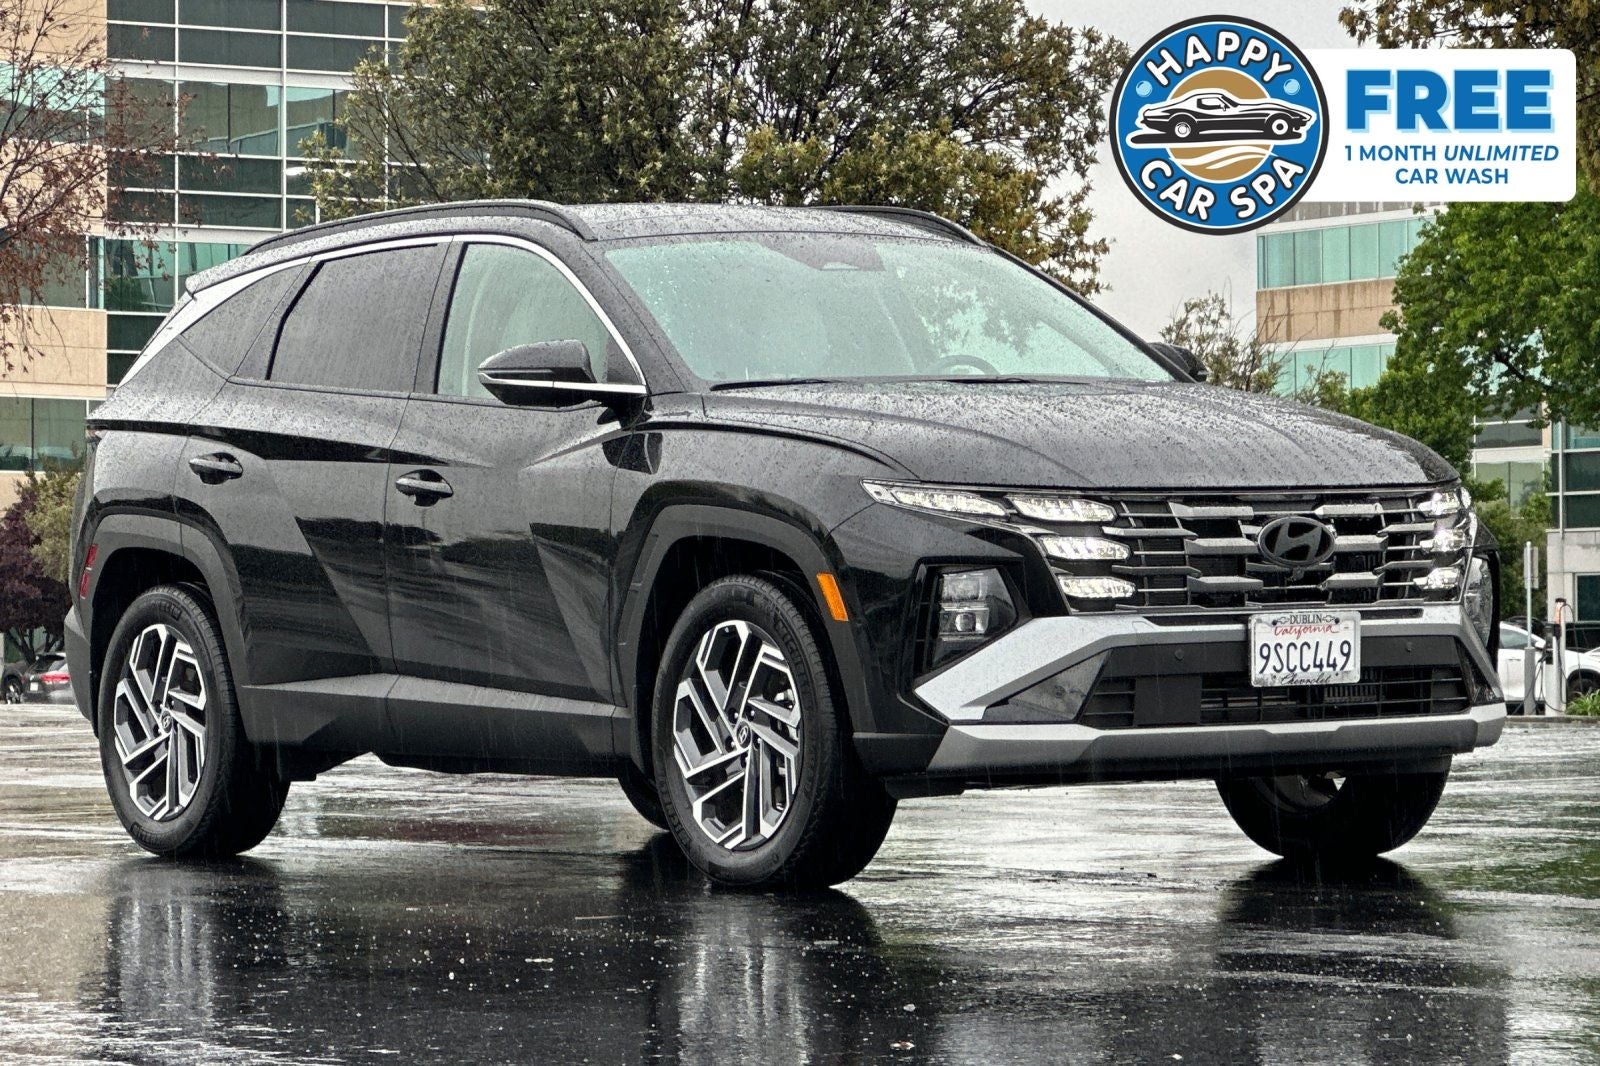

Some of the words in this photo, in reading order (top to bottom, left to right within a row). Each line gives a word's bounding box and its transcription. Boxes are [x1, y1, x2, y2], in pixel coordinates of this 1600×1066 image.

[1289, 614, 1322, 624] DUBLIN
[1274, 624, 1340, 639] California
[1258, 640, 1352, 675] 9SCC449
